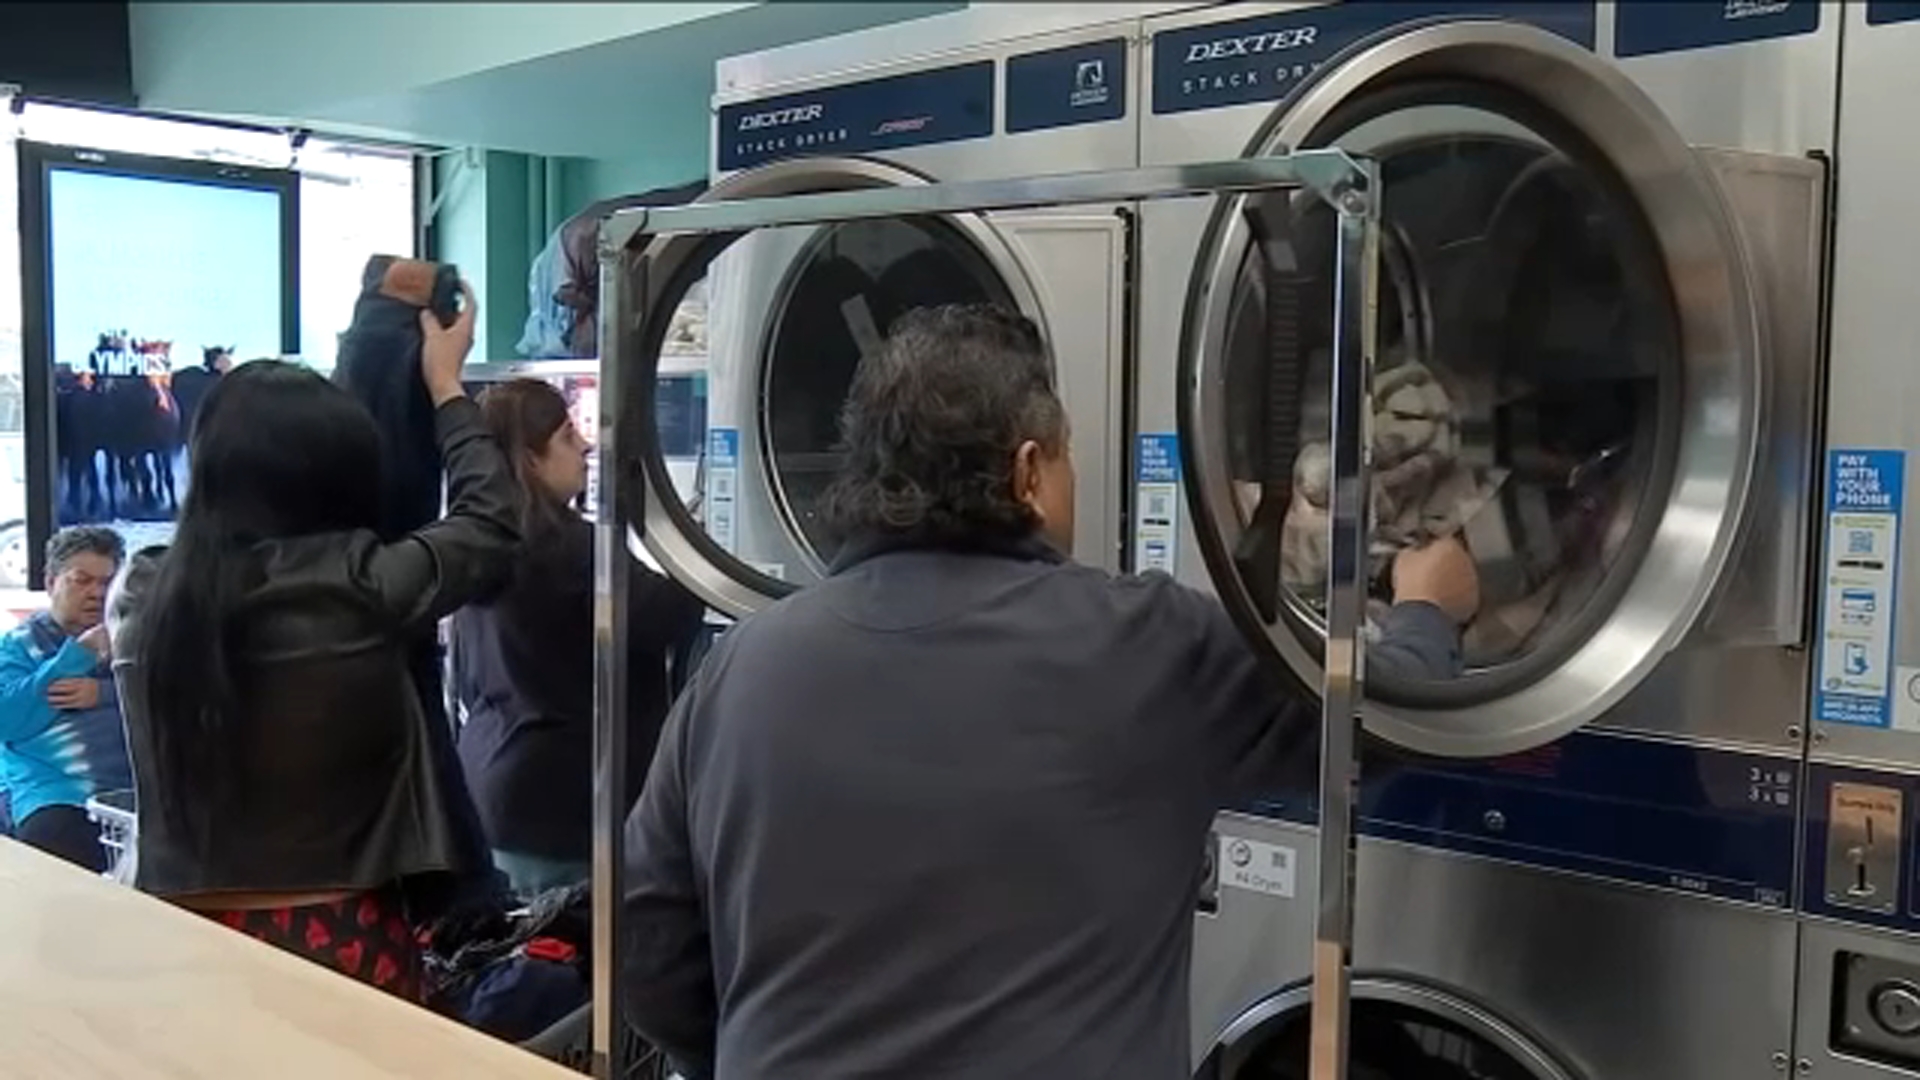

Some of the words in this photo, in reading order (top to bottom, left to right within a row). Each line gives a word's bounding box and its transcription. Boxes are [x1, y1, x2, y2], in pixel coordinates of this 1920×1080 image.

[1185, 26, 1318, 63] DEXTER
[1182, 70, 1258, 94] STACK
[1276, 62, 1322, 82] DRY
[738, 104, 823, 131] DEXTER
[737, 138, 785, 155] STACK
[796, 128, 847, 147] DRYER
[1838, 455, 1867, 467] PAY
[1836, 468, 1879, 479] WITH
[1836, 480, 1881, 492] YOUR
[1836, 491, 1891, 505] PHONE
